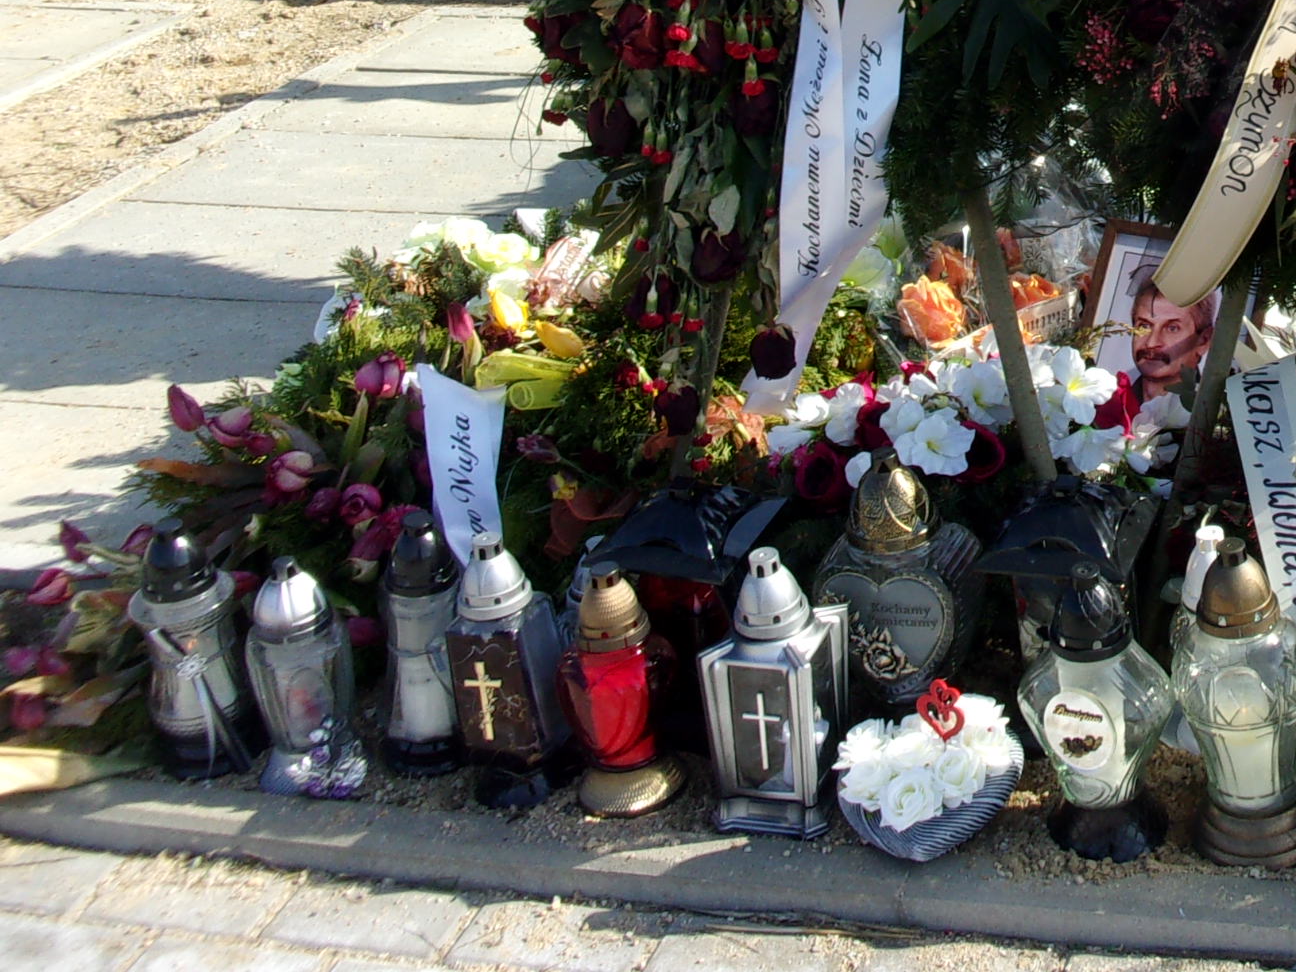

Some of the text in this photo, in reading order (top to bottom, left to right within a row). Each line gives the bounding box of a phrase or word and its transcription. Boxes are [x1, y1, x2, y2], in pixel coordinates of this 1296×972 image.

[817, 21, 829, 35] i
[802, 38, 828, 139] Mężowi
[857, 108, 868, 121] z
[797, 144, 821, 279] Kochanemu
[448, 412, 480, 503] Wujka
[871, 602, 932, 619] Kochamy
